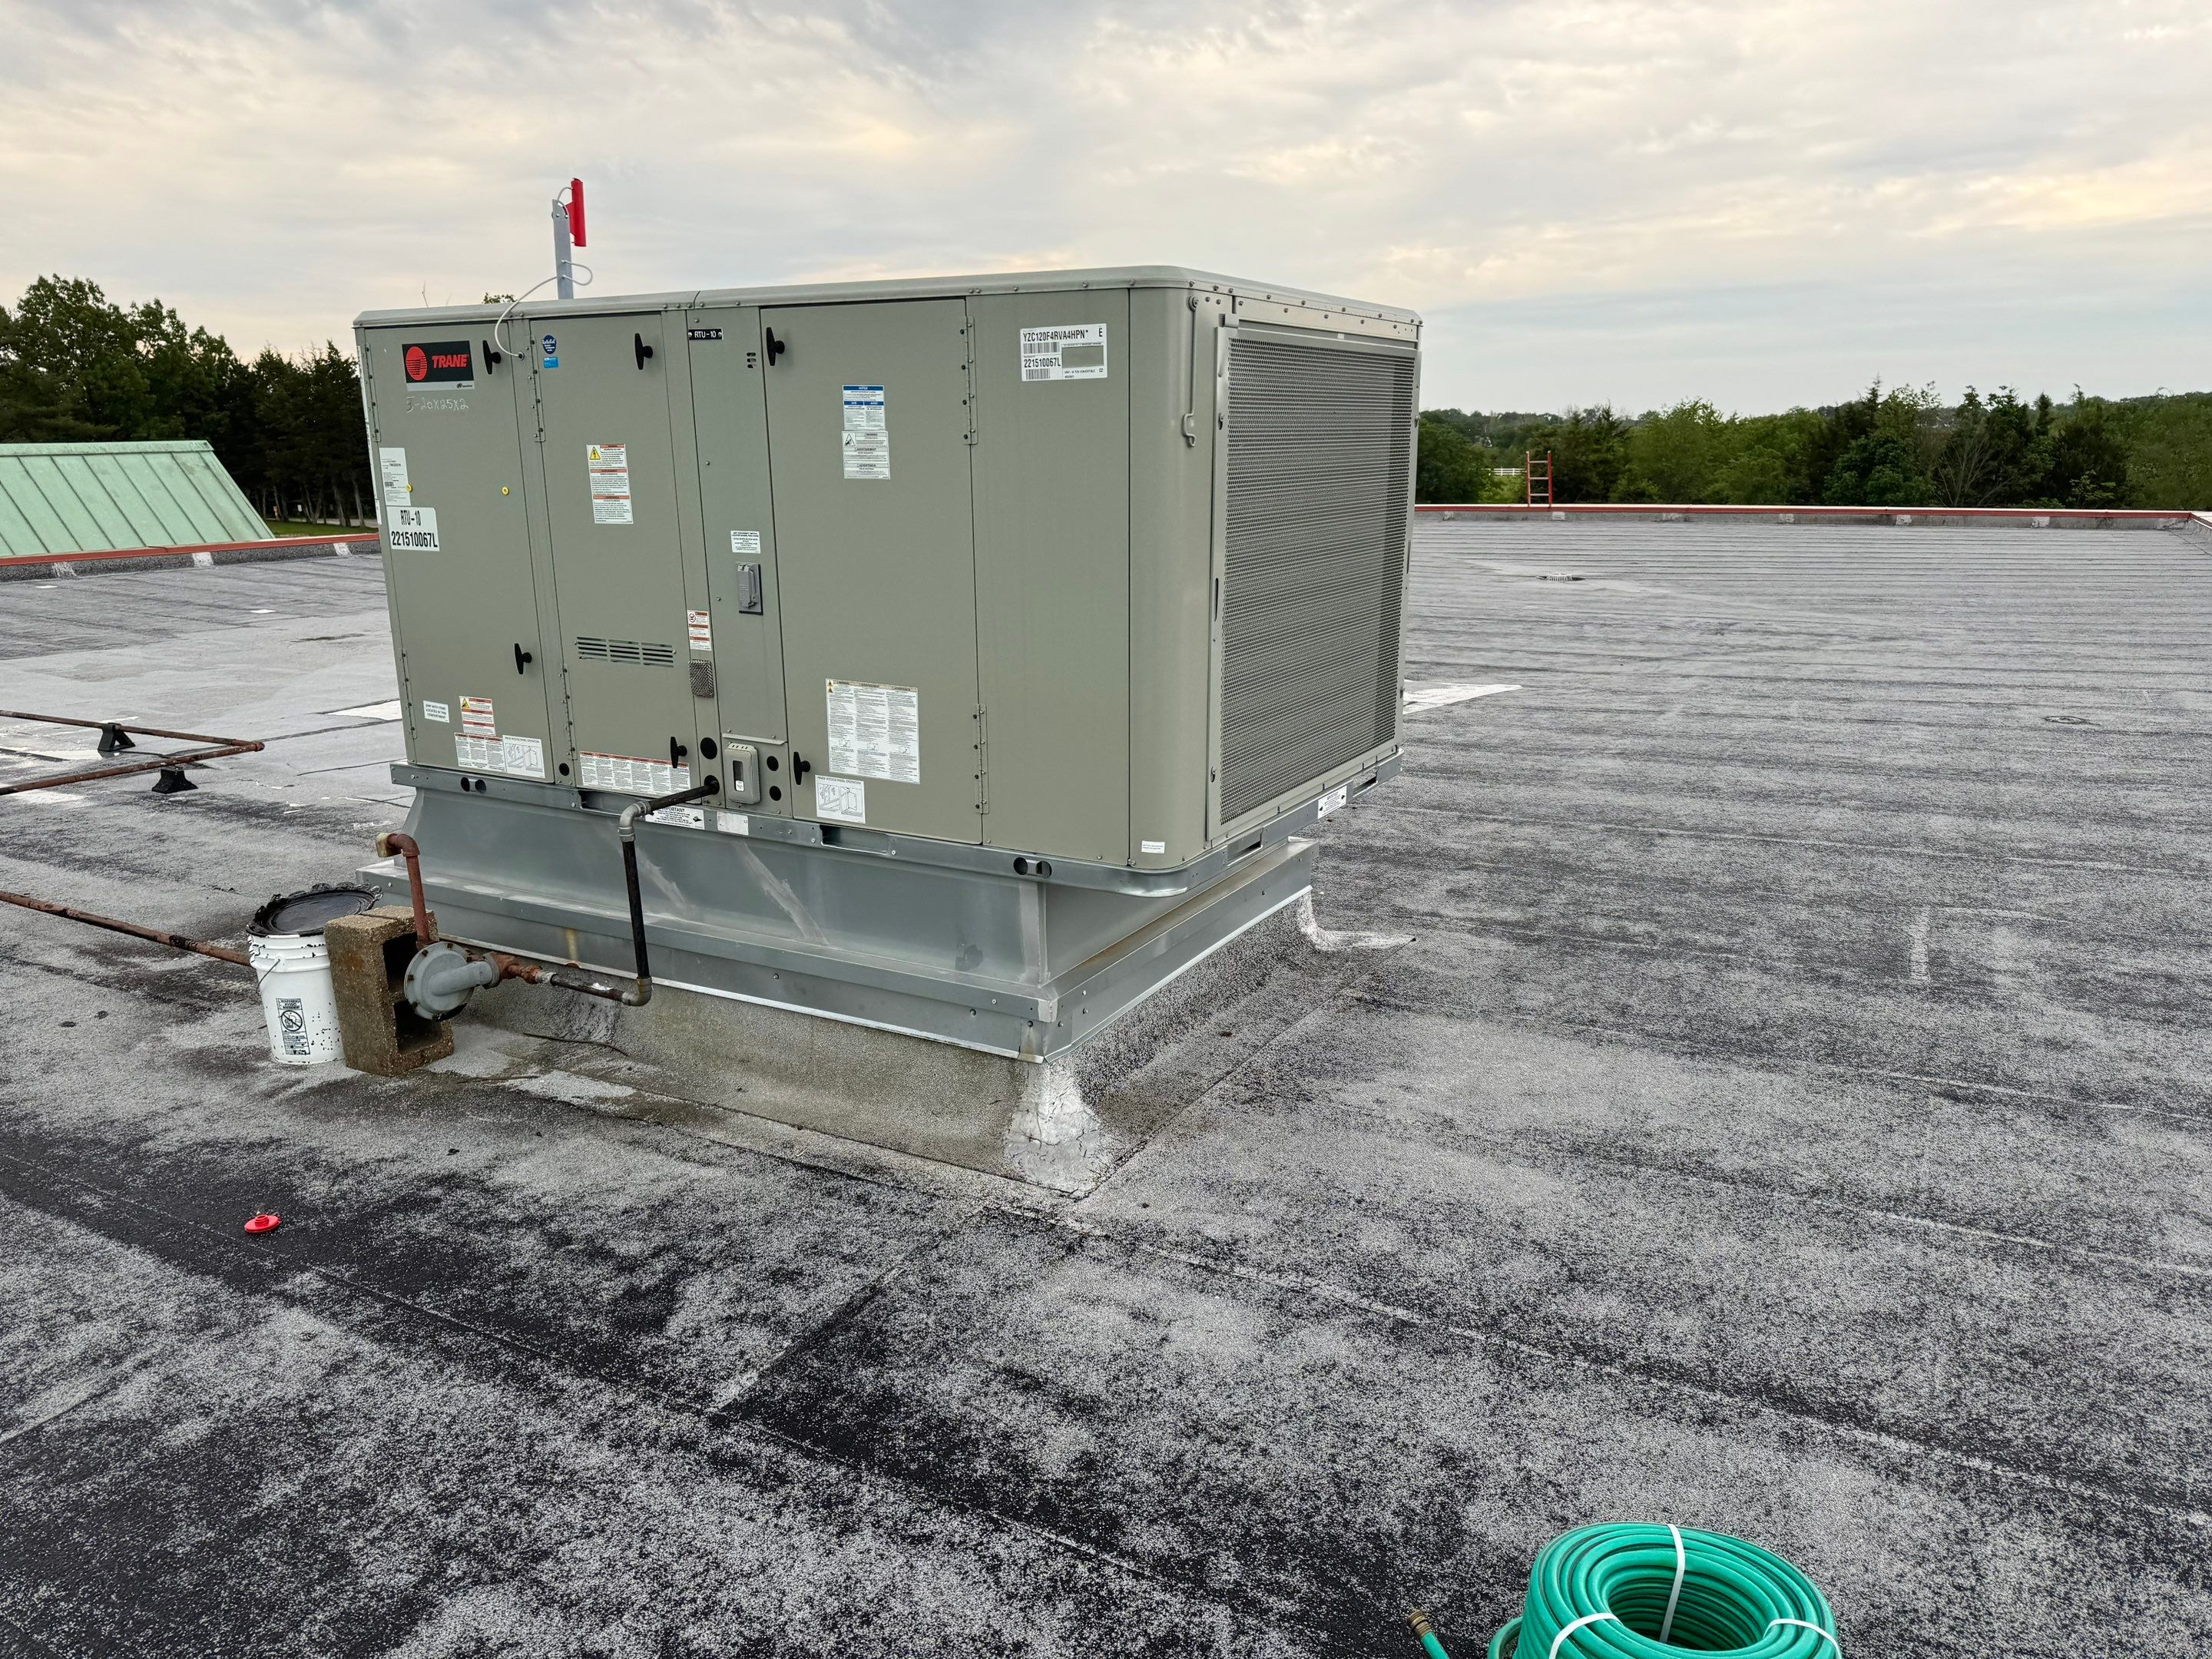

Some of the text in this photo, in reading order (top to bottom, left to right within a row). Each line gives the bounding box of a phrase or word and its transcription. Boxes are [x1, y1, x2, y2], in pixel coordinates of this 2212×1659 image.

[694, 330, 717, 339] RTU-10
[1098, 327, 1103, 337] E
[432, 353, 468, 369] TRANE
[1024, 357, 1061, 368] 221510067L
[400, 509, 421, 526] RTU-10
[391, 531, 439, 548] 221510067L
